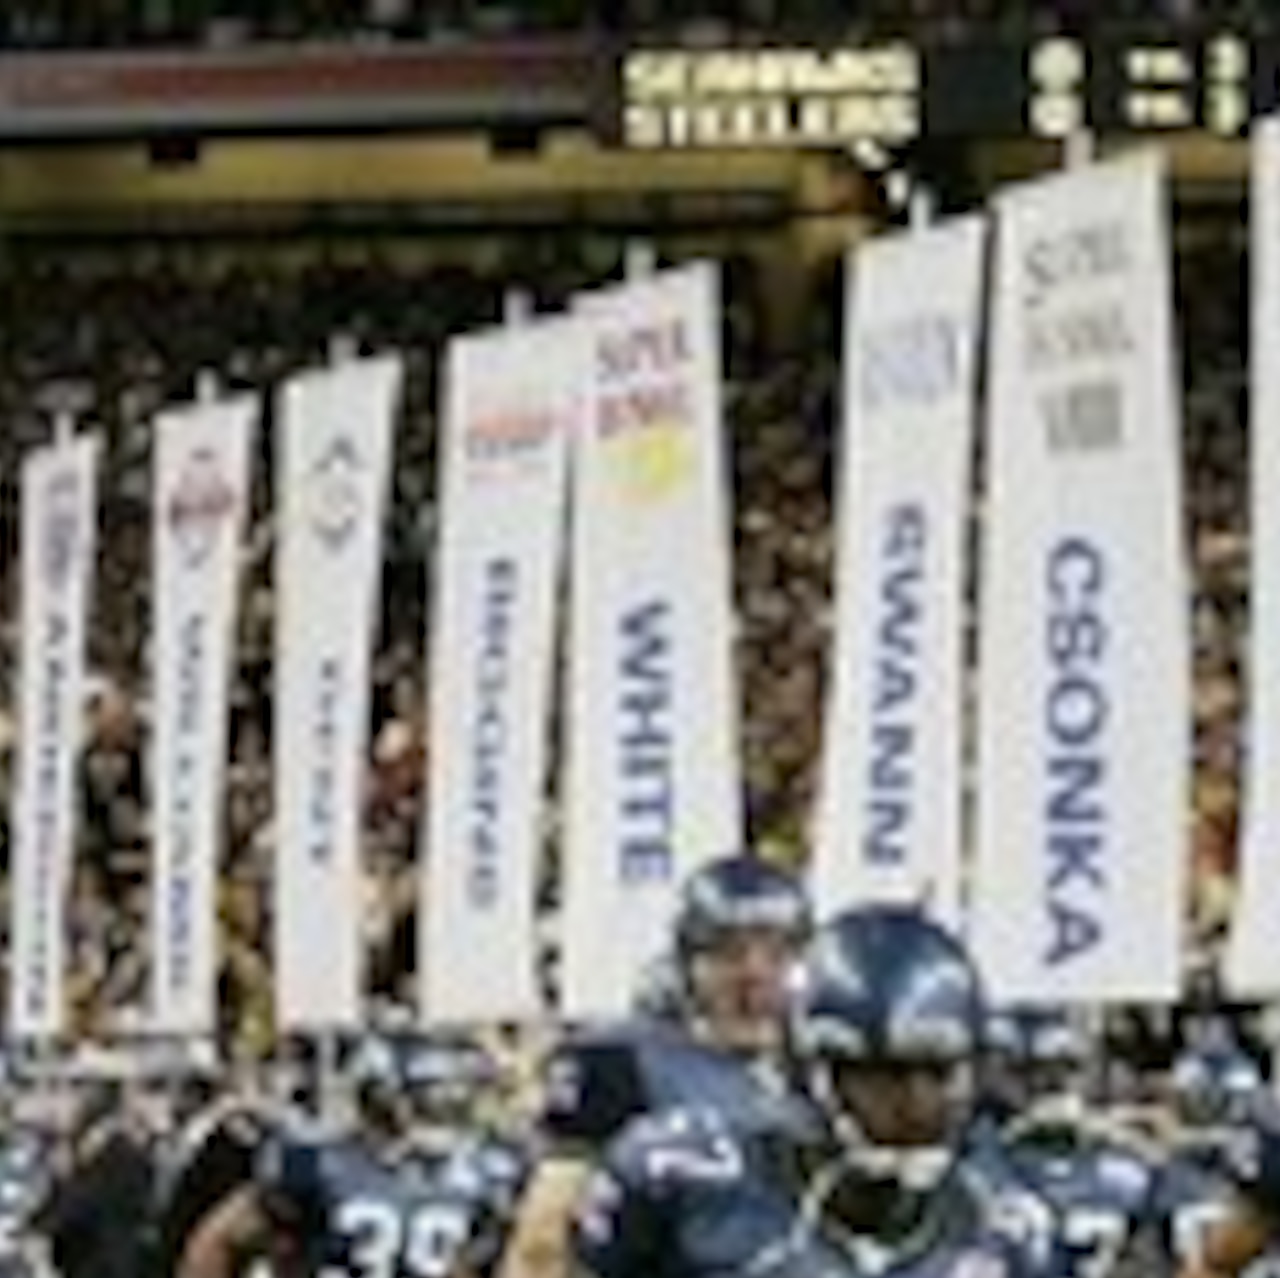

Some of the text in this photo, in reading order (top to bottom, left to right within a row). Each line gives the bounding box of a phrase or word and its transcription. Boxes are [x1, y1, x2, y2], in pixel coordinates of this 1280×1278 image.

[618, 600, 673, 880] WHITE
[861, 503, 927, 864] SWANN
[1042, 537, 1110, 968] CSONKA
